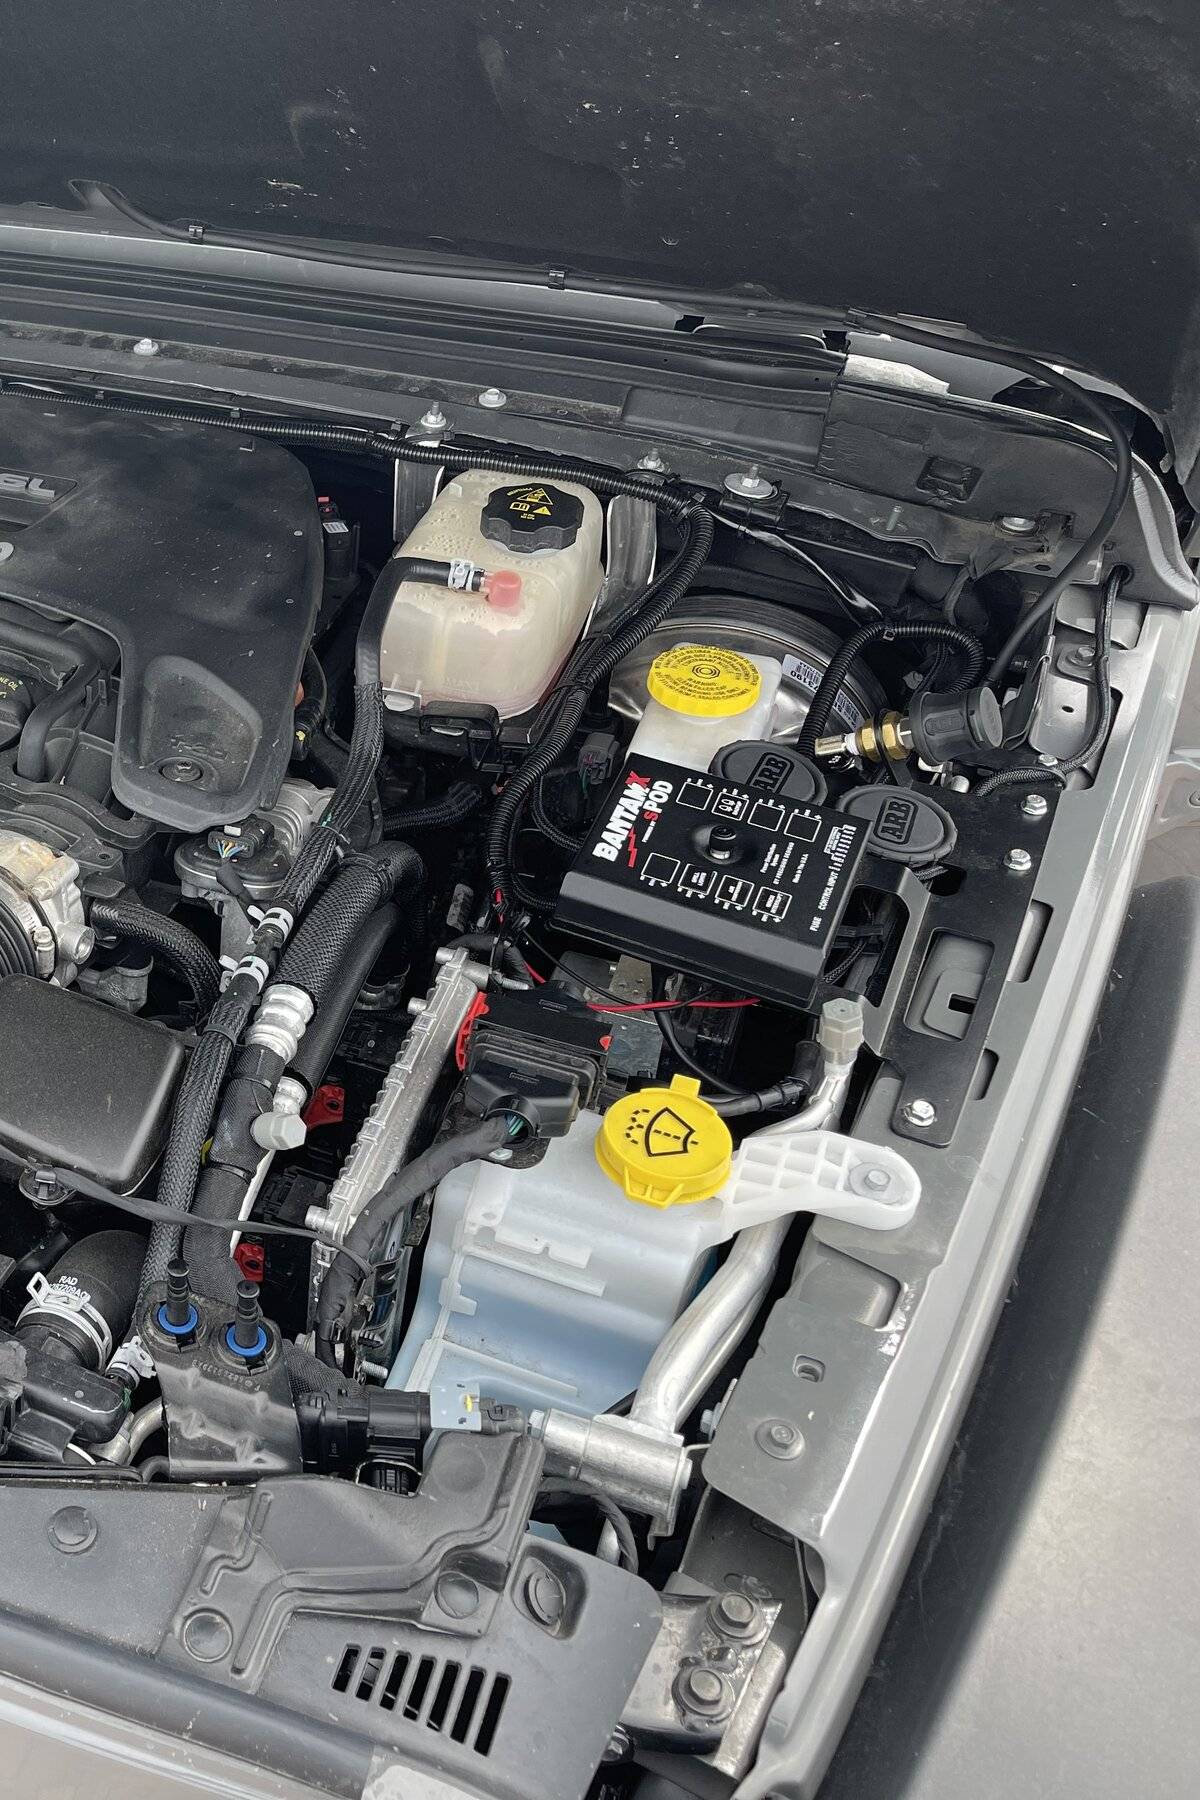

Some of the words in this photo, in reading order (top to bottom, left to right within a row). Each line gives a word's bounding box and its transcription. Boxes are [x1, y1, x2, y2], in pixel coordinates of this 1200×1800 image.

[8, 679, 19, 691] OIL
[754, 756, 789, 792] ARB
[881, 801, 912, 839] ARB
[809, 916, 822, 932] FUSE
[58, 1275, 79, 1286] RAD
